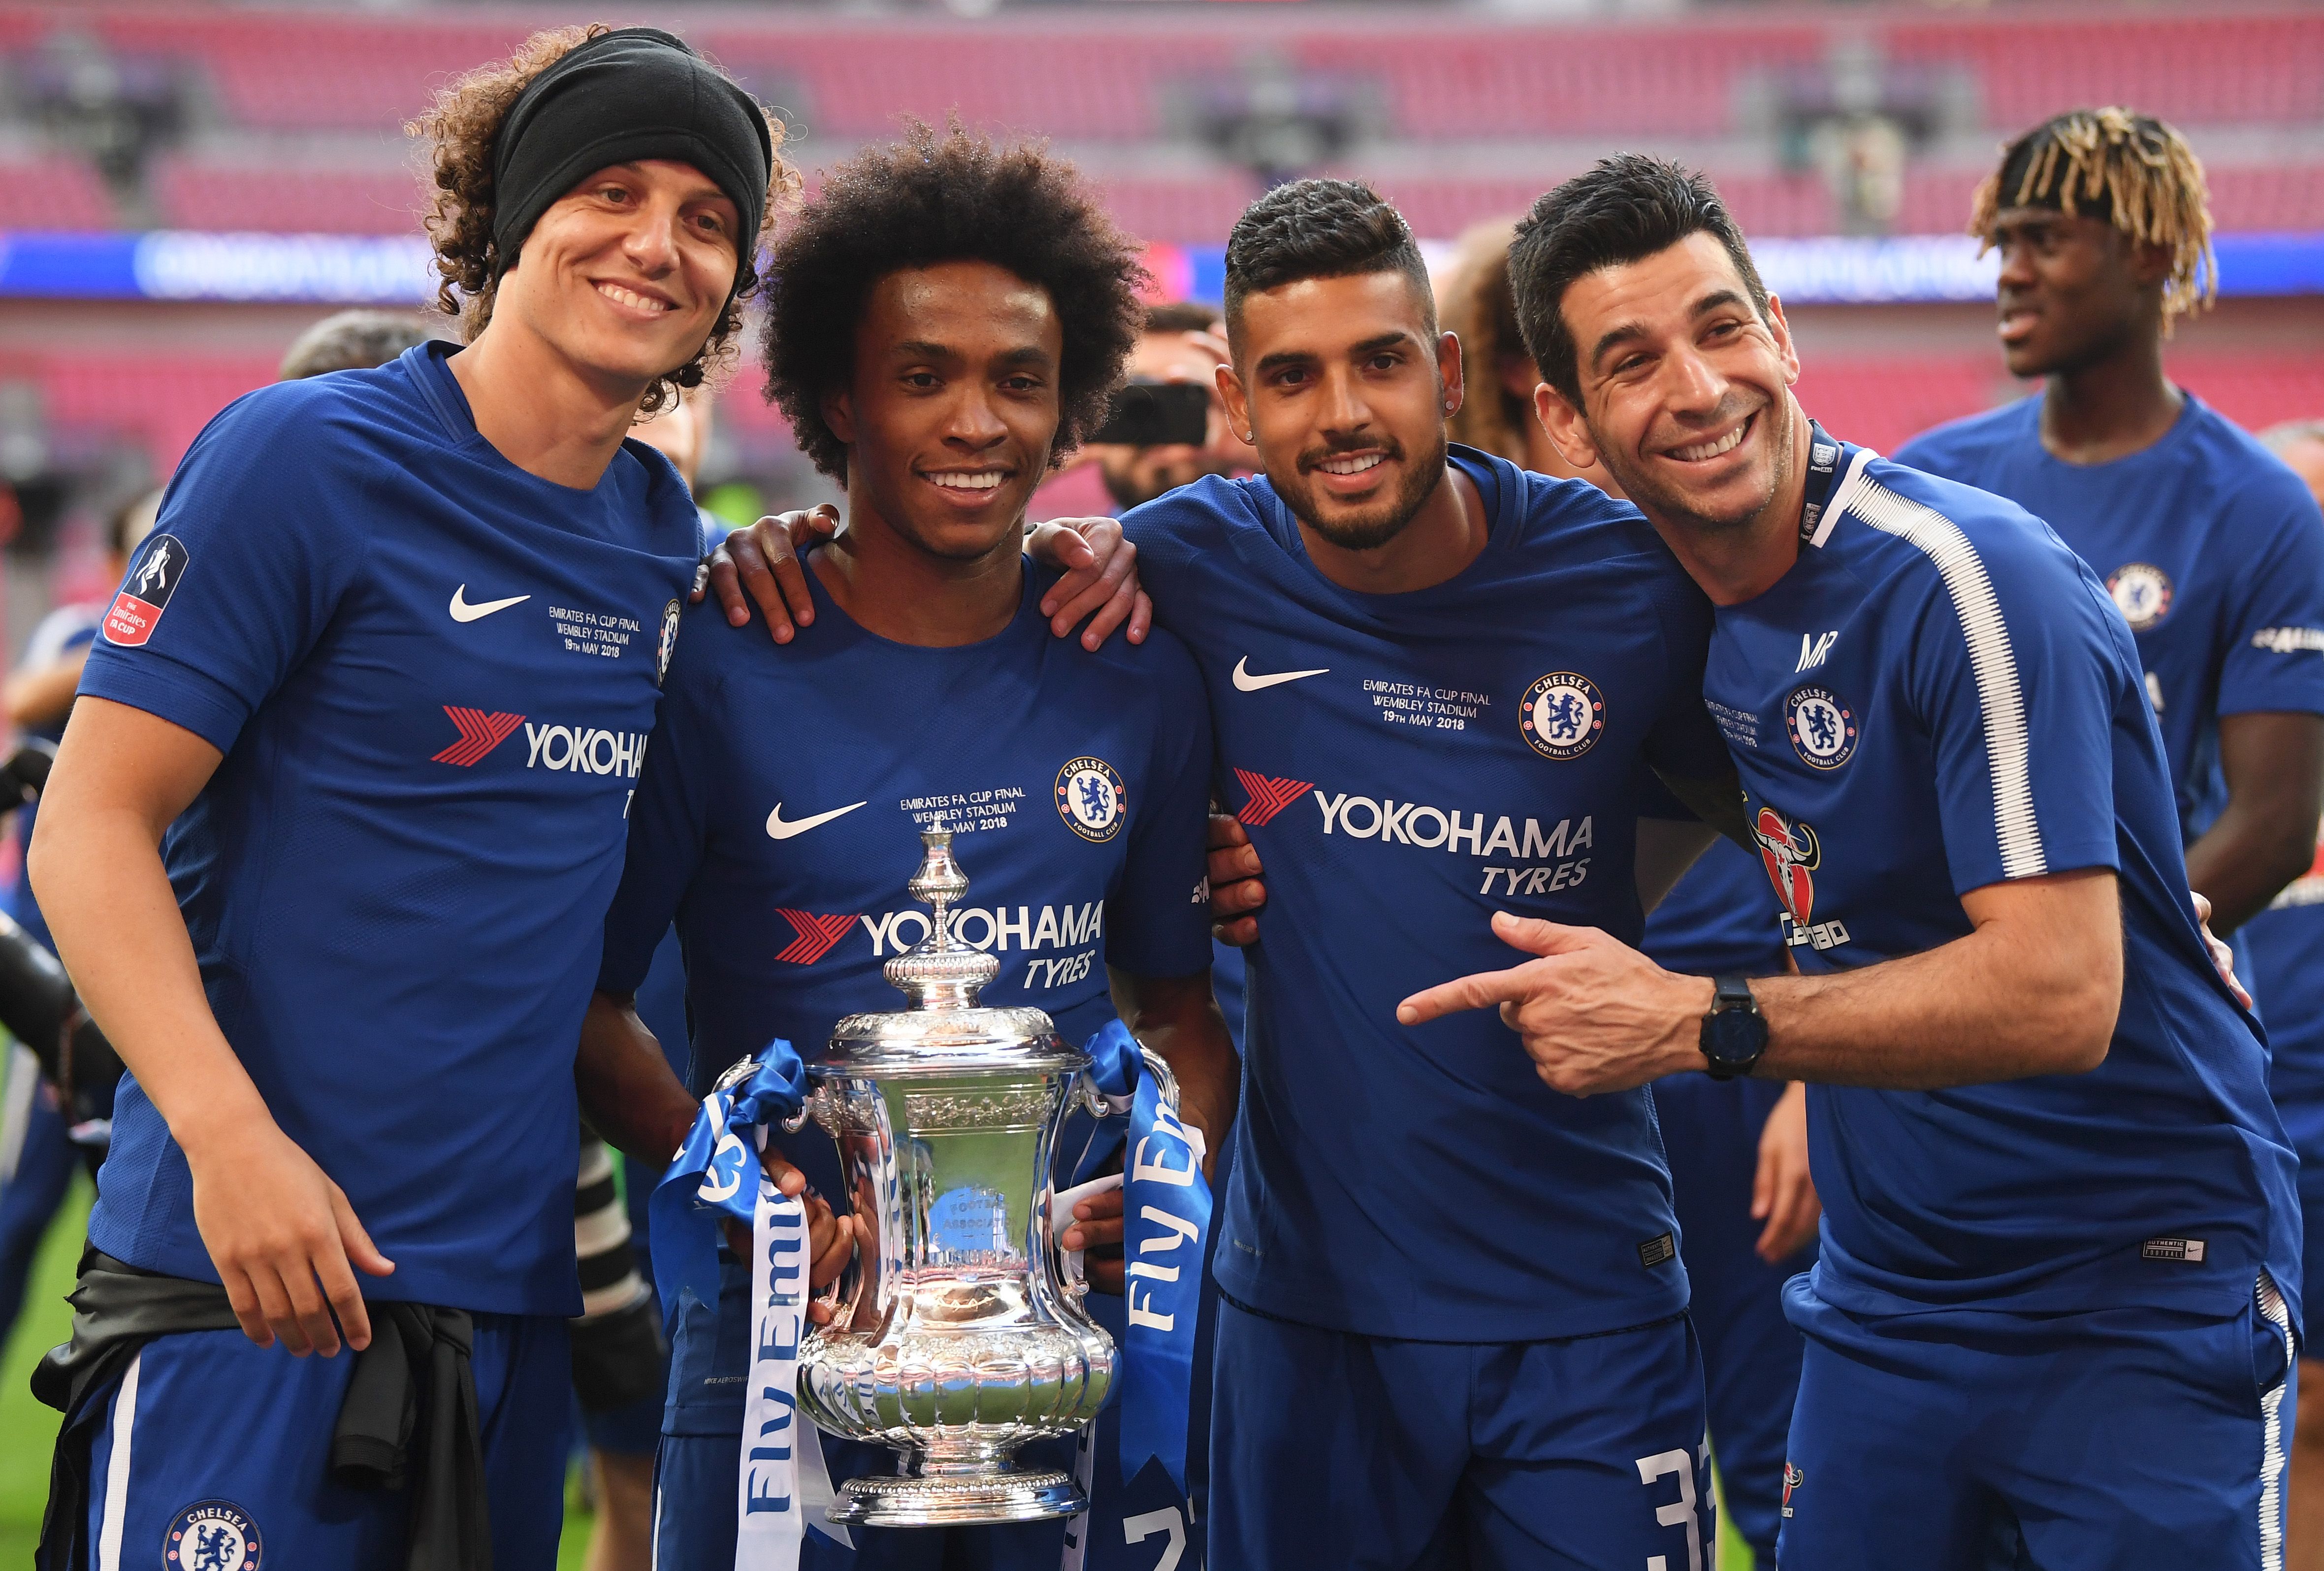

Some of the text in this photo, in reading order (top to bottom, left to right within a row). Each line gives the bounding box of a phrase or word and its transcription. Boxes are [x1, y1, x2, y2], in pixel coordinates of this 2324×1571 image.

[113, 606, 147, 628] Emirates
[127, 602, 137, 611] THE
[109, 619, 136, 635] FA CUP
[549, 606, 640, 632] EMIRATES FA CUP FINAL
[556, 622, 629, 645] WEMBLEY STADIUM
[582, 642, 599, 655] MAY
[601, 645, 619, 658] 2018
[1363, 680, 1491, 706] EMIRATES FA CUP FINAL
[1534, 675, 1591, 694] CHELSEA
[1373, 694, 1477, 718] WEMBLEY STADIUM
[1790, 688, 1834, 708] CHELSEA
[1409, 714, 1434, 727] MAY
[1436, 717, 1465, 730] 2018
[524, 722, 647, 778] YOKOHA
[1534, 739, 1591, 755] FOOTBALL CLUB
[1804, 747, 1849, 765] FOOTBALL CLUB
[1064, 759, 1110, 778] CHELSEA
[900, 787, 1026, 811] EMIRATES FA CUP FINAL
[912, 801, 1016, 823] WEMBLEY STADIUM
[953, 820, 976, 834] MAY
[980, 817, 1008, 830] 2018
[1074, 821, 1118, 838] FOOTBALL CLUB
[1314, 790, 1592, 858] YOKOHAMA
[1479, 857, 1591, 896] TYRES
[1024, 949, 1096, 989] TYRES
[2145, 1249, 2183, 1258] FOOTBALL
[1129, 1205, 1199, 1332] Fly
[717, 1375, 749, 1384] AEROSWIF
[746, 1386, 796, 1516] Fly
[187, 1507, 248, 1531] CHELSEA
